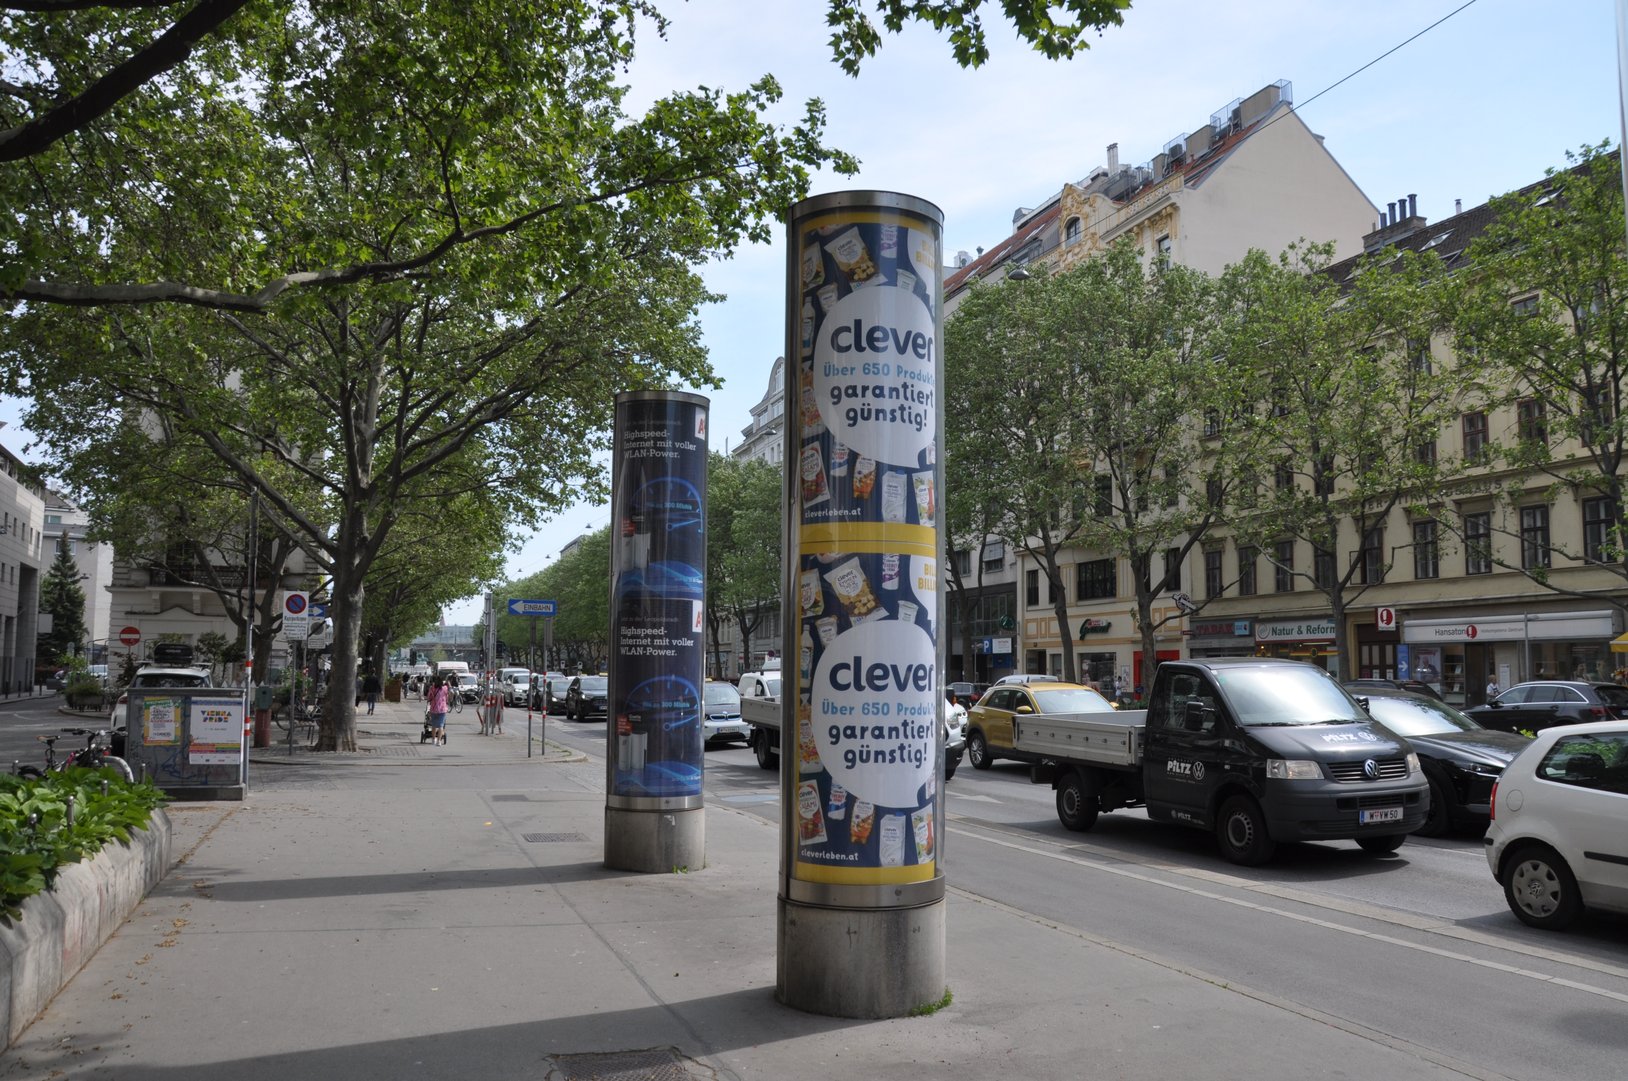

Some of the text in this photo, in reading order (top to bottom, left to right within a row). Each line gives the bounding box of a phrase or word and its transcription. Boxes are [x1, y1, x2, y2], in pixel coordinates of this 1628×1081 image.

[830, 318, 934, 362] clever
[823, 361, 856, 378] Über
[862, 362, 890, 377] 650
[830, 382, 934, 408] garantiert
[845, 402, 927, 432] günstig!
[624, 429, 670, 440] Highspeed-
[624, 439, 697, 451] Internet mit voller
[624, 448, 680, 459] WLAN-Power.
[804, 507, 861, 518] cleverleben.at
[620, 626, 668, 637] Highspeed-
[1271, 626, 1294, 636] Natur
[1296, 624, 1303, 635] &
[1434, 628, 1466, 637] Hansaton
[620, 637, 694, 647] Internet mit voller
[983, 640, 990, 653] P
[620, 646, 678, 657] WLAN-Power.
[829, 655, 934, 692] clever
[822, 698, 855, 715] Über
[861, 702, 890, 716] 650
[828, 718, 934, 746] garantiert
[843, 742, 927, 770] günstig!
[1369, 812, 1375, 820] W
[1389, 809, 1398, 818] 50
[801, 848, 859, 861] cleverleben.at
